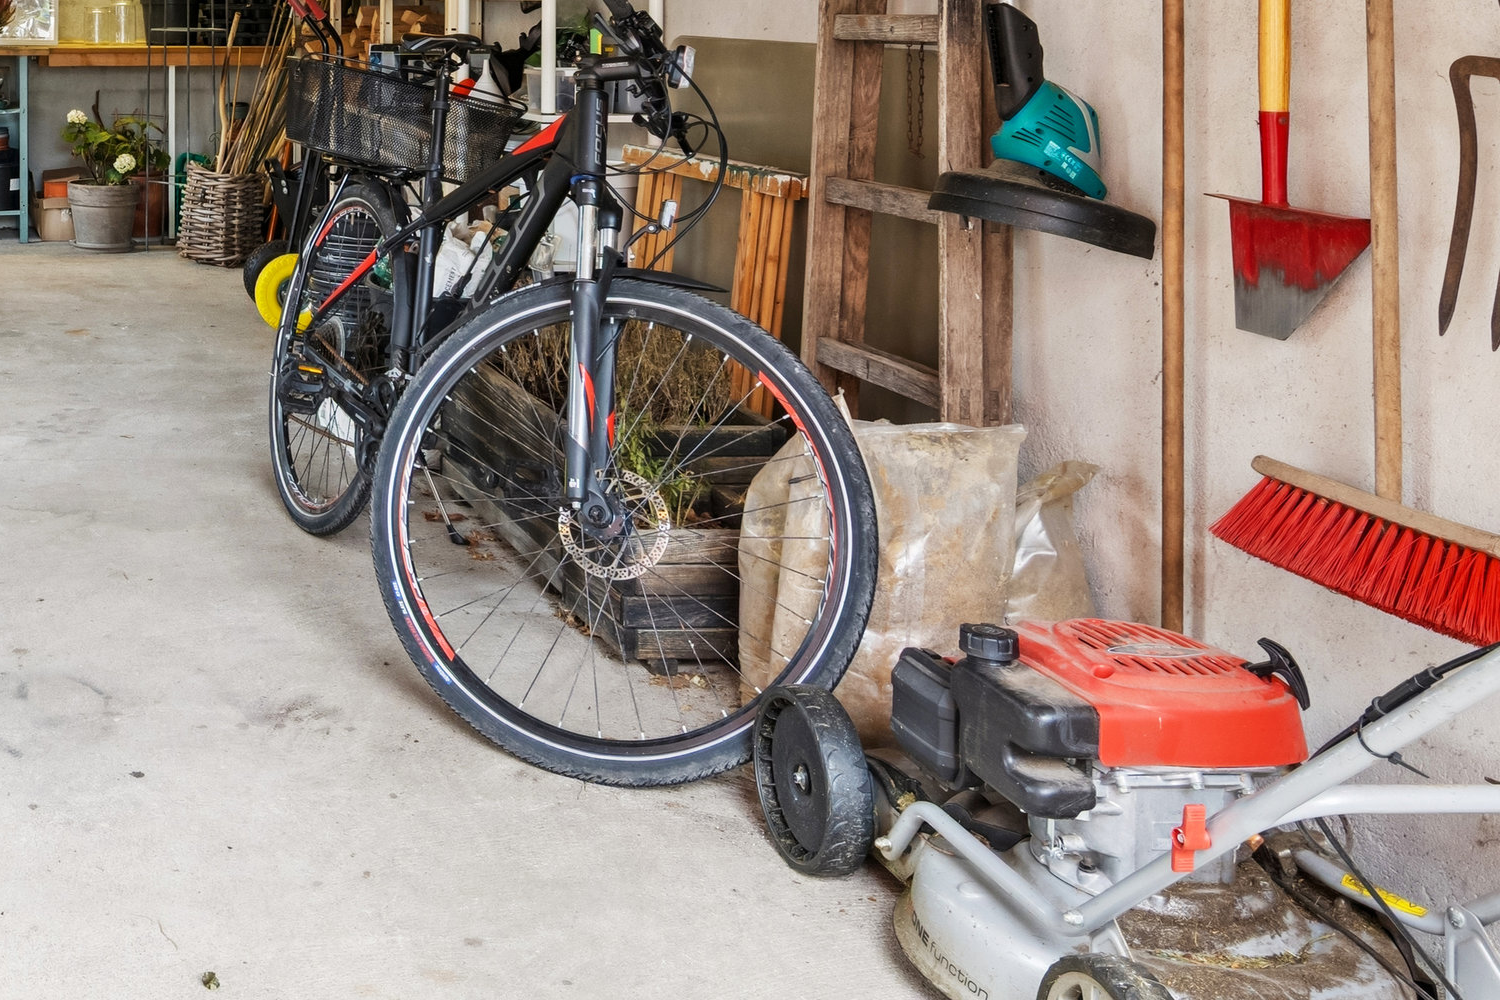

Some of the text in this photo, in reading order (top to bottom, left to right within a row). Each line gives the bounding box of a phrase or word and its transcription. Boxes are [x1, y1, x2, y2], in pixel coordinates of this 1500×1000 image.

[594, 98, 603, 166] FOCUS
[911, 910, 989, 1000] ONE function
